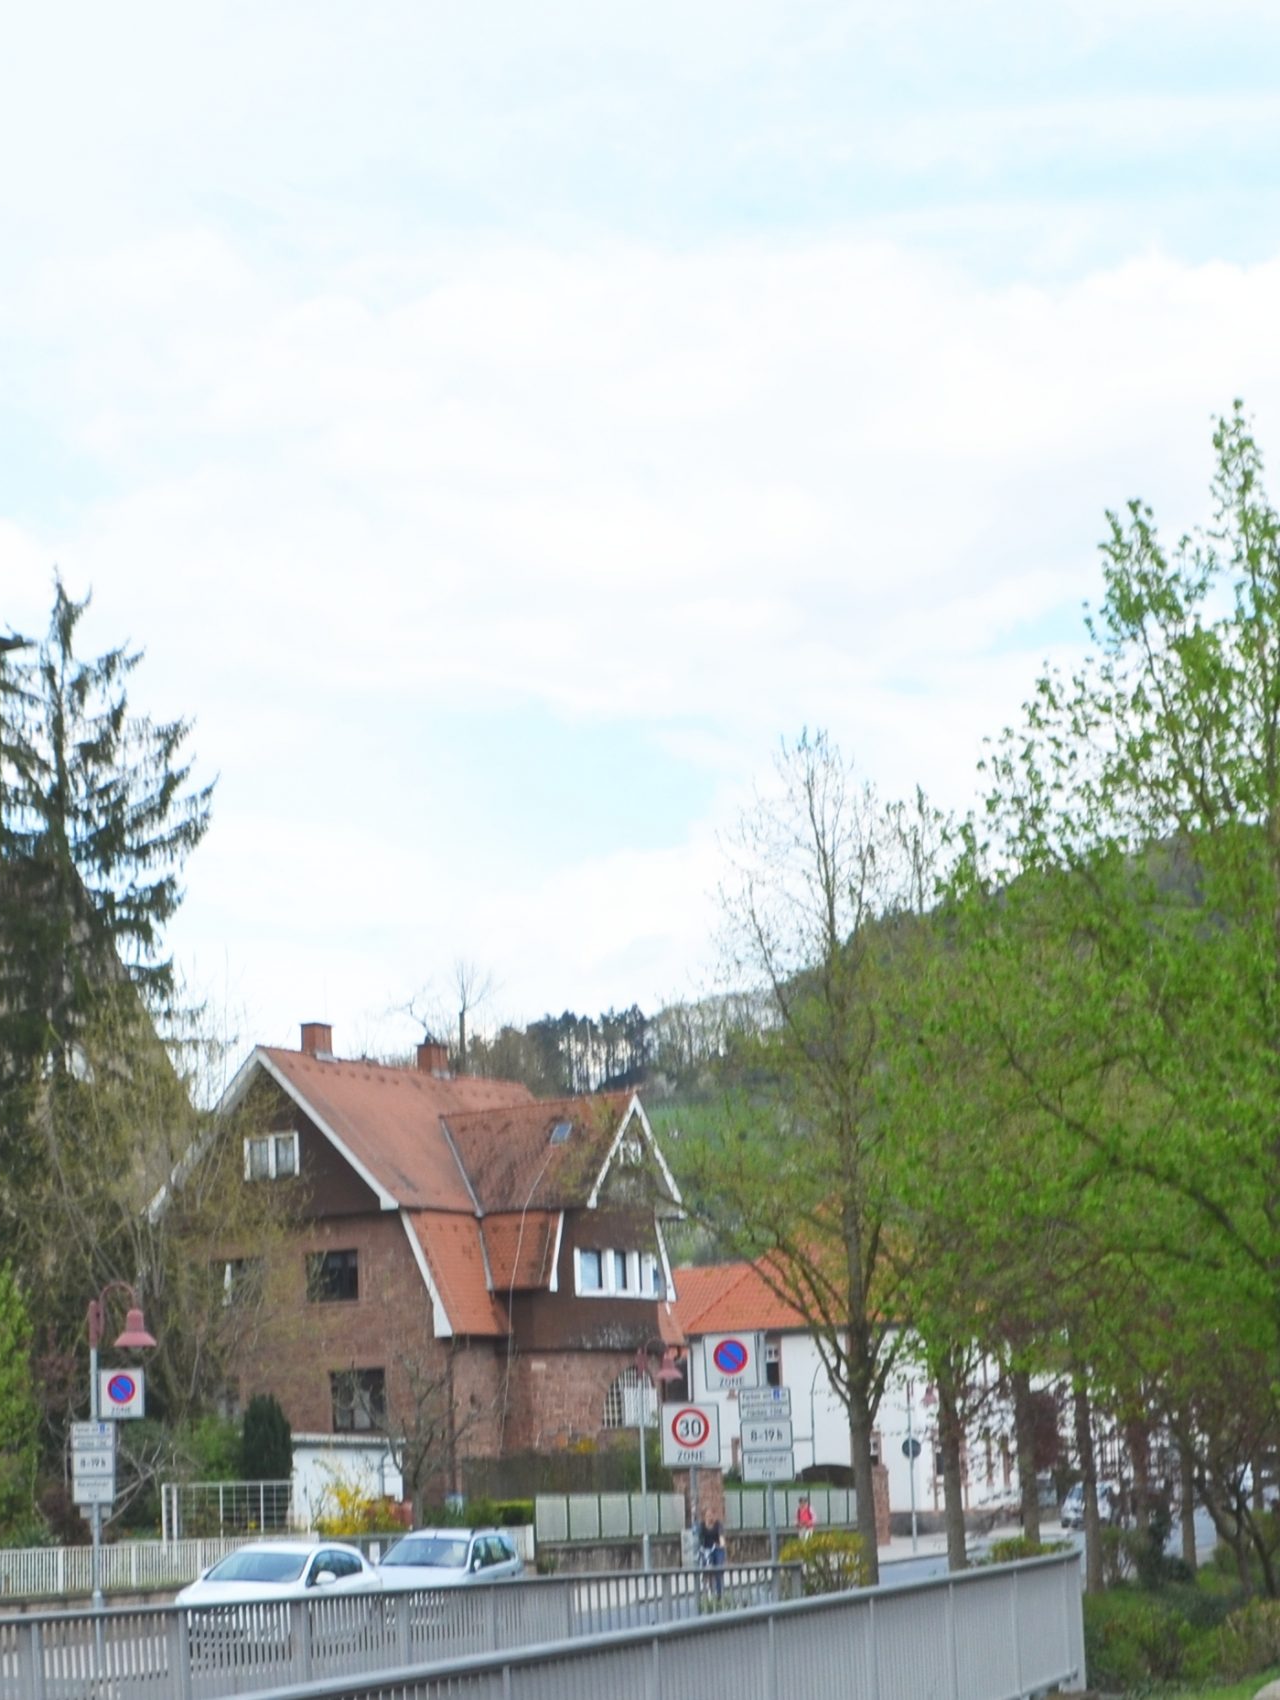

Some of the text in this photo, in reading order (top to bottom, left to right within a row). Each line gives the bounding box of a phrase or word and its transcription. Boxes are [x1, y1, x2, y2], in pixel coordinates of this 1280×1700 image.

[720, 1376, 744, 1387] ZONE
[679, 1419, 702, 1437] 30
[677, 1450, 705, 1462] ZONE
